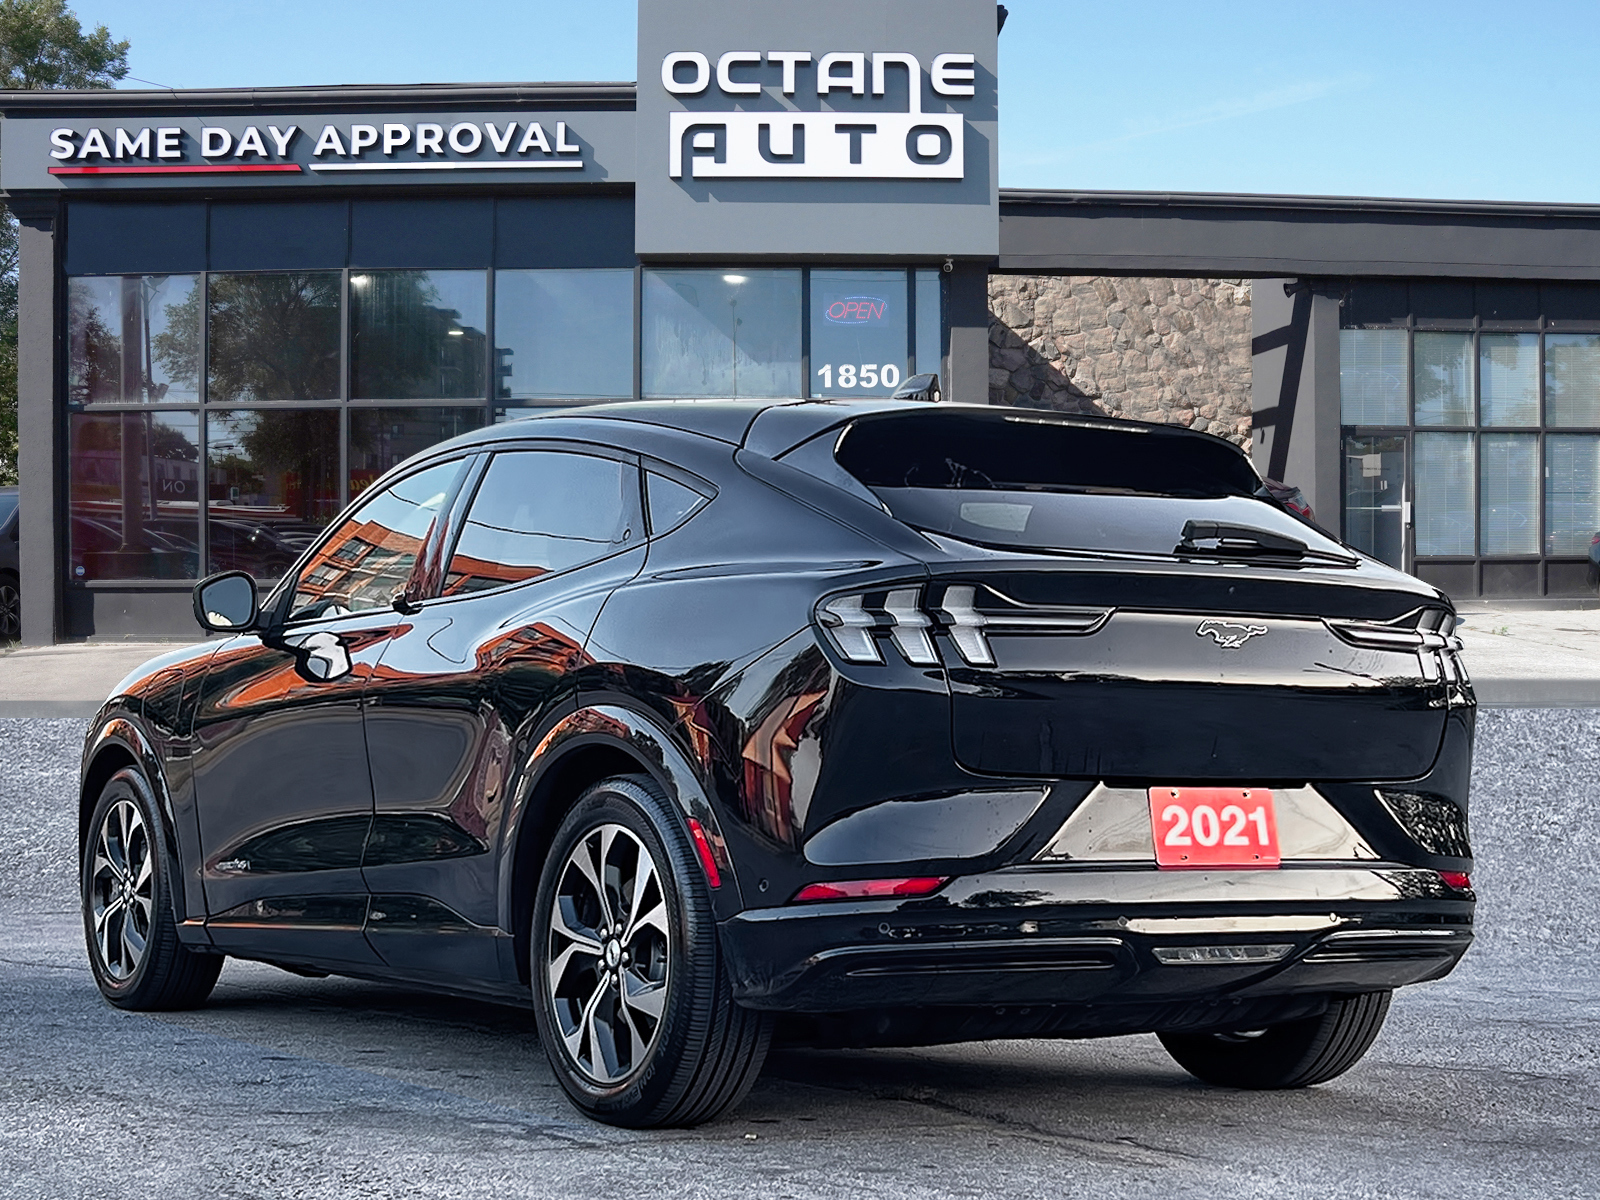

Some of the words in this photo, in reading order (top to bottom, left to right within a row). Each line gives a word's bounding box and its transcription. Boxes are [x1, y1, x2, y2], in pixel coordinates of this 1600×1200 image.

[661, 50, 976, 98] OCTANE
[49, 126, 181, 160] SAME
[200, 124, 299, 157] DAY
[313, 120, 580, 156] APPROVAL
[681, 123, 952, 178] AUTO
[829, 301, 885, 320] OPEN
[817, 363, 900, 388] 1850
[1161, 804, 1270, 847] 2021
